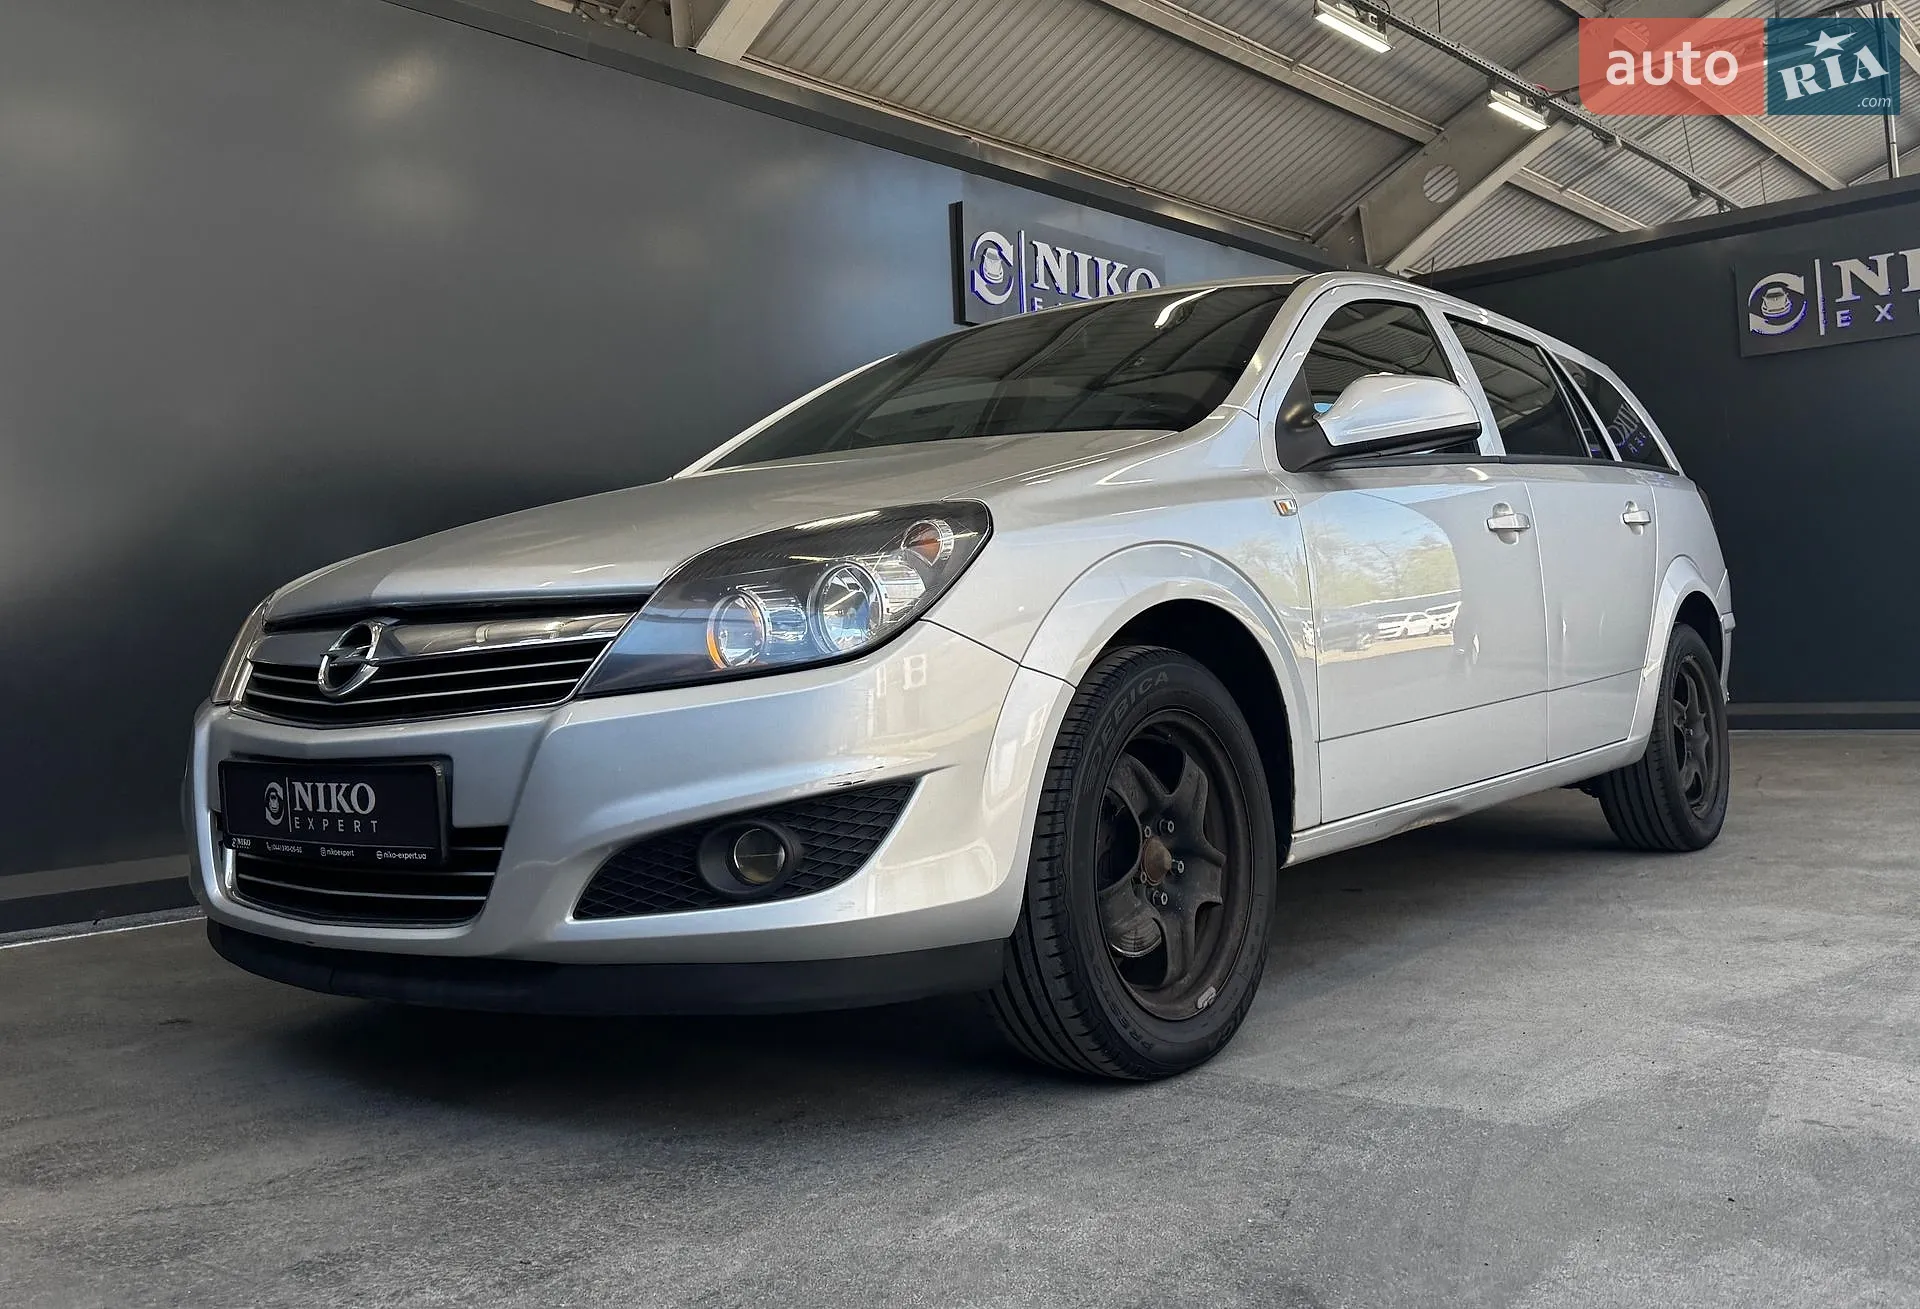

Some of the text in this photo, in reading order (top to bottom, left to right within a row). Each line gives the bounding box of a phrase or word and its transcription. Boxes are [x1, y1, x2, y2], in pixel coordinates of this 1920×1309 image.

[1030, 240, 1161, 299] NIKO
[1832, 248, 1920, 303] NI
[291, 781, 376, 815] NIKO
[294, 816, 378, 833] EXPERT
[384, 850, 427, 861] niko-expert.ua
